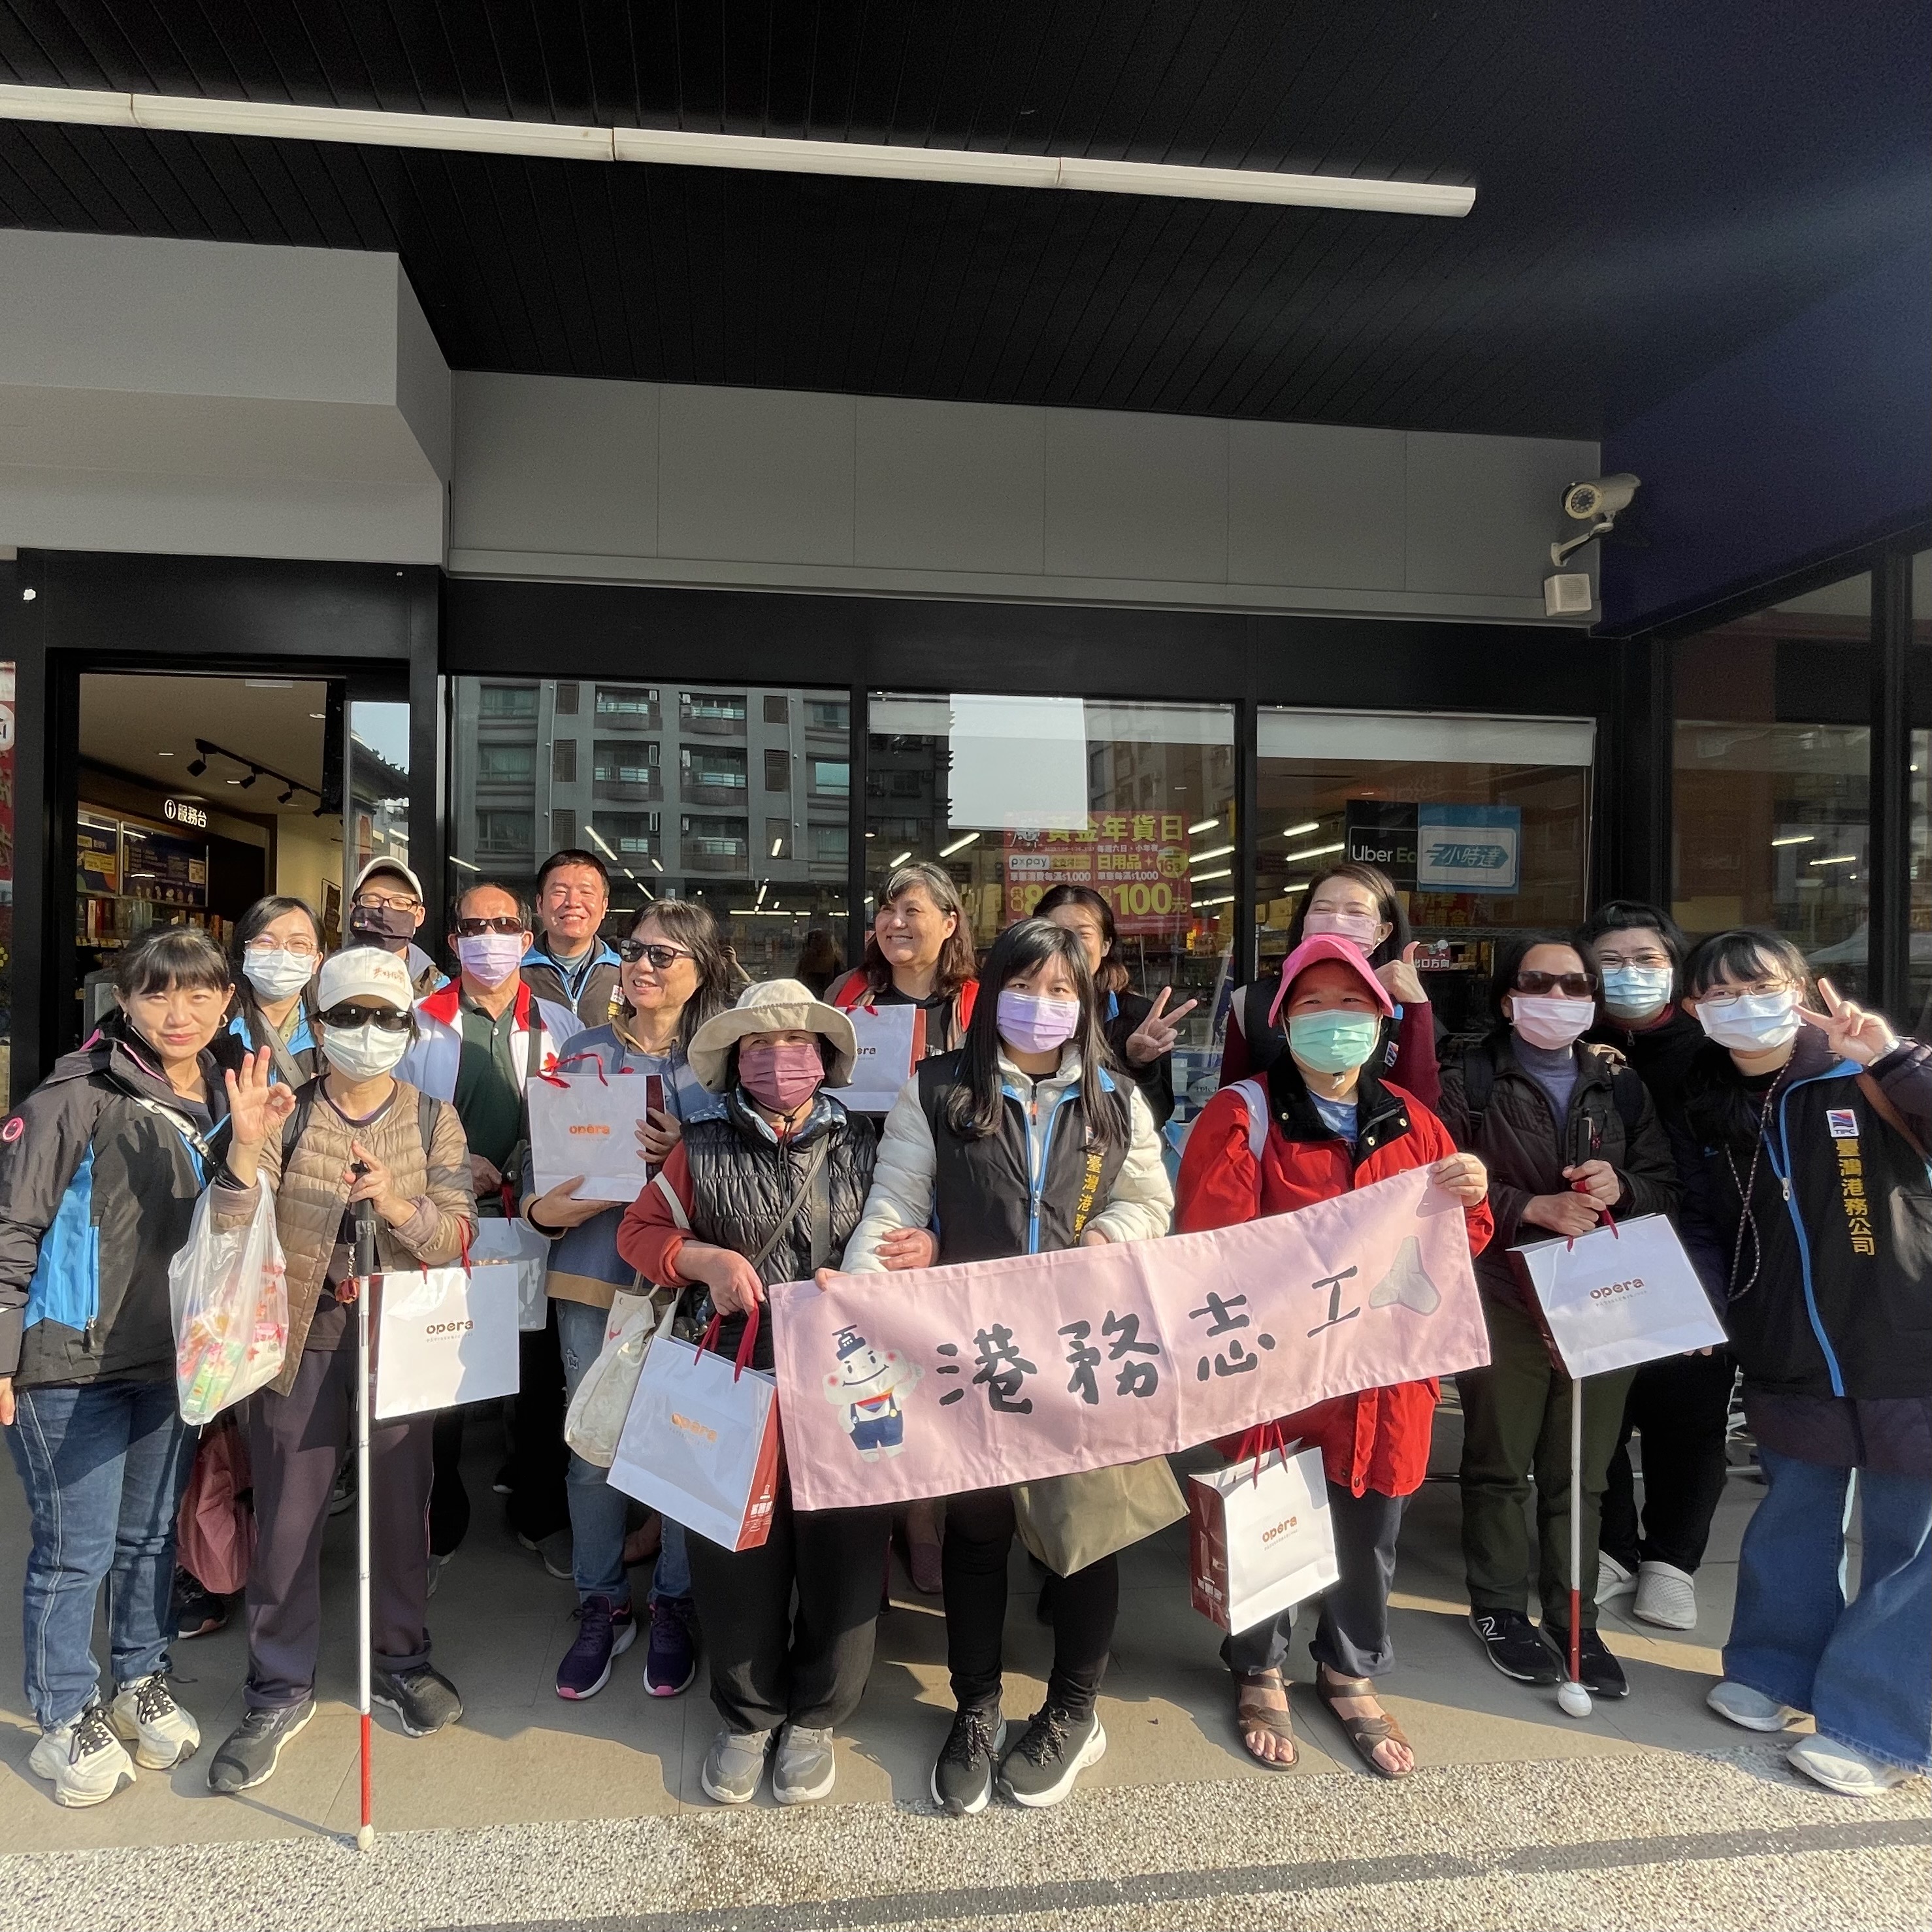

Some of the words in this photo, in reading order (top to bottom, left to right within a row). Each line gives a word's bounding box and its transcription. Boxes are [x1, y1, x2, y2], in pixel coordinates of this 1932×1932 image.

[178, 804, 207, 828] 服務台
[1098, 854, 1142, 870] 日用品
[1352, 845, 1393, 862] Uber
[1442, 846, 1499, 868] 小時達
[1835, 1138, 1875, 1256] 臺灣港務公司
[936, 1265, 1361, 1415] 港務志工
